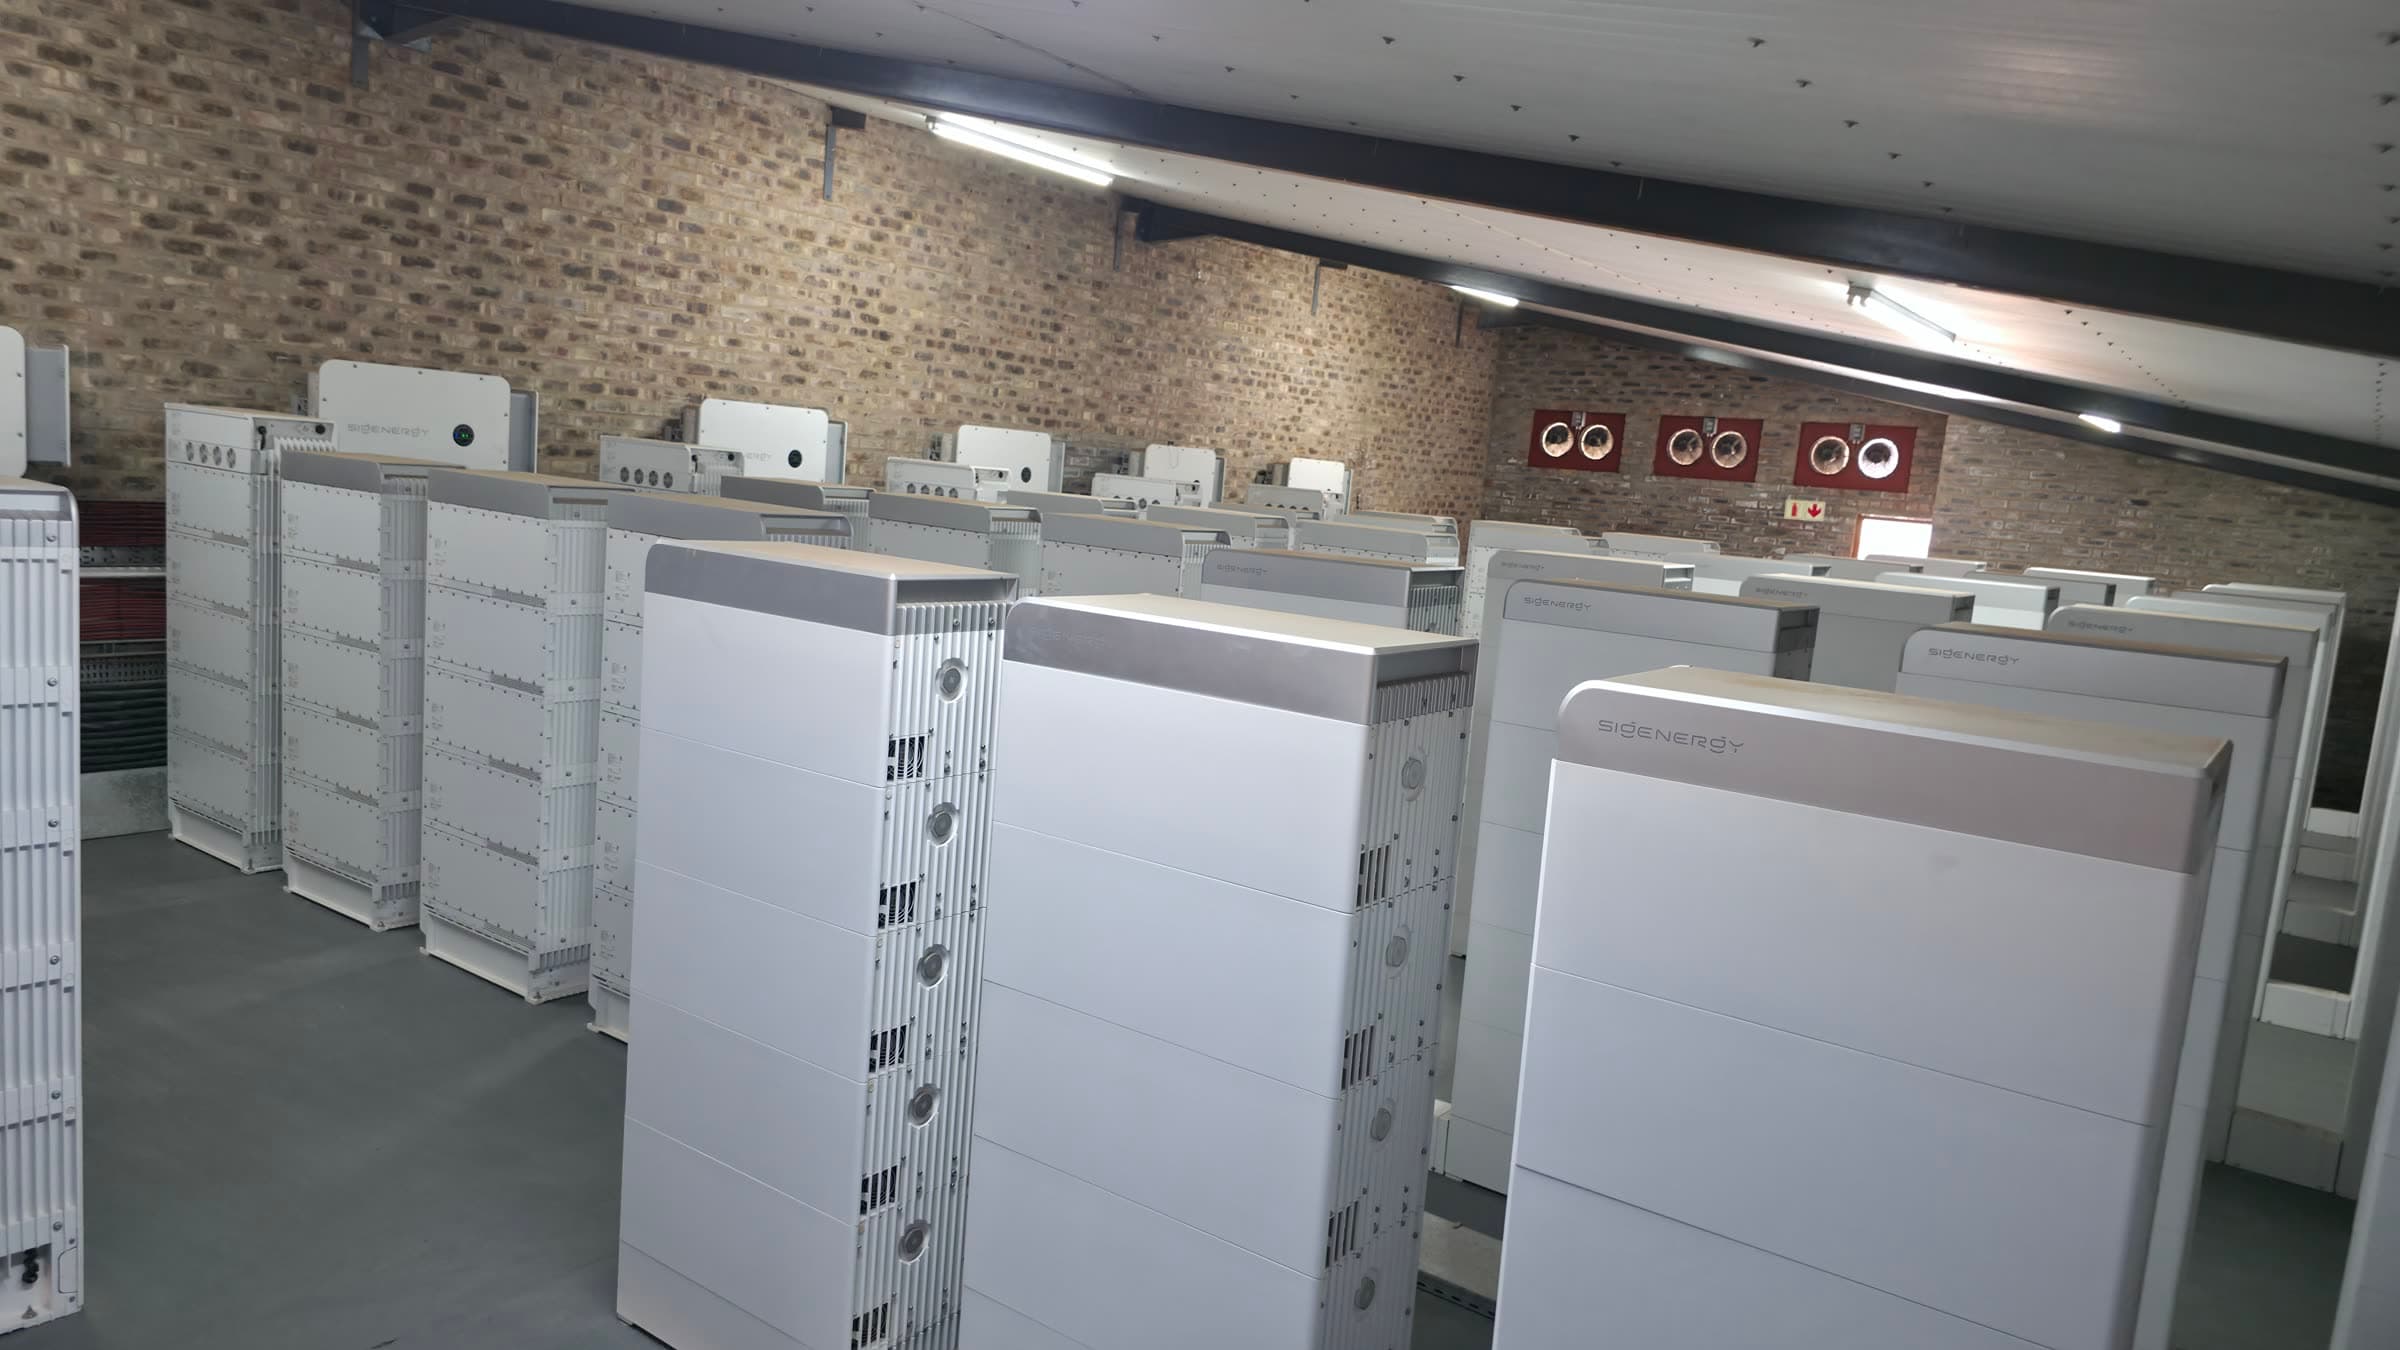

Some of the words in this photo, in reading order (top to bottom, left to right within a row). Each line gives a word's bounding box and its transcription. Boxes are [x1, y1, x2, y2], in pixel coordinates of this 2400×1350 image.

[1523, 596, 1592, 612] SIGENERGY
[1928, 647, 2019, 666] SIGENERGY
[1598, 719, 1745, 754] SIGENERGY
